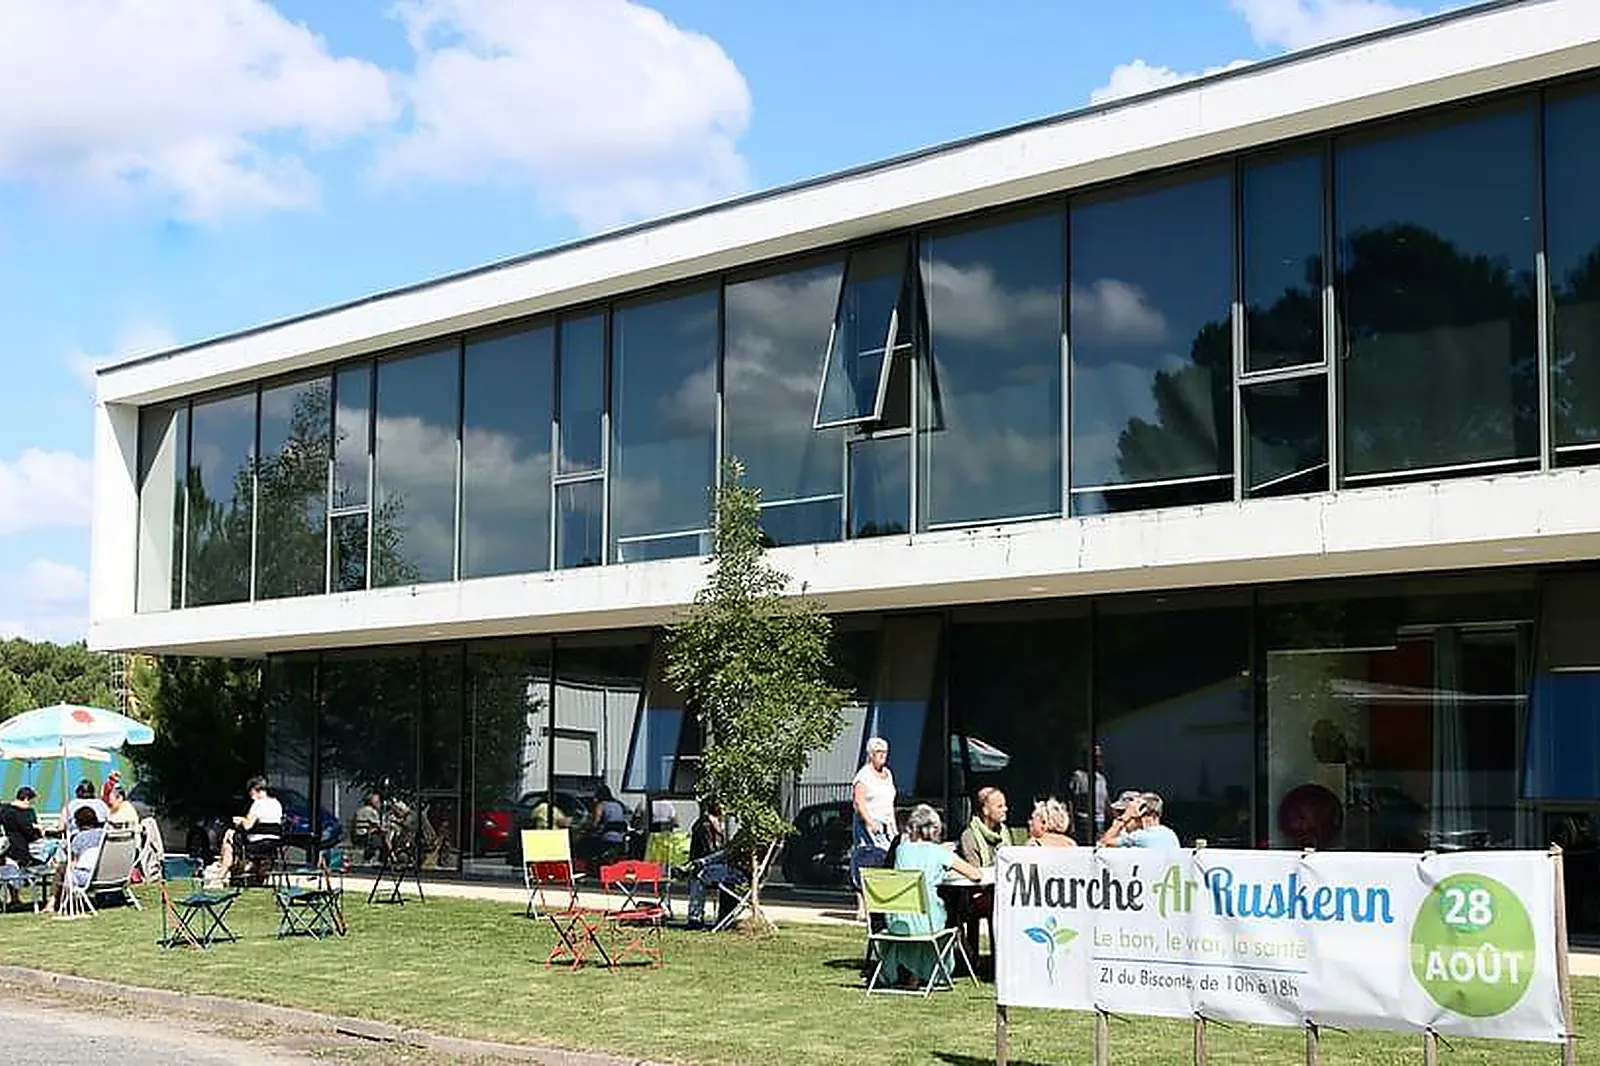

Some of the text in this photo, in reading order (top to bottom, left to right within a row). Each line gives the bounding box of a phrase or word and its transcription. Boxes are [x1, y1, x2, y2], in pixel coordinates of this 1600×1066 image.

[1005, 862, 1395, 924] Marché Ar Ruskenn
[1444, 887, 1493, 925] 28
[1093, 926, 1113, 947] Le
[1119, 927, 1159, 952] bon,
[1166, 927, 1181, 951] le
[1232, 932, 1248, 955] la
[1424, 942, 1525, 984] AOÛT
[1117, 968, 1136, 985] du
[1199, 973, 1219, 990] de
[1227, 974, 1254, 992] 10h
[1258, 978, 1268, 994] à
[1271, 977, 1299, 997] 18h
